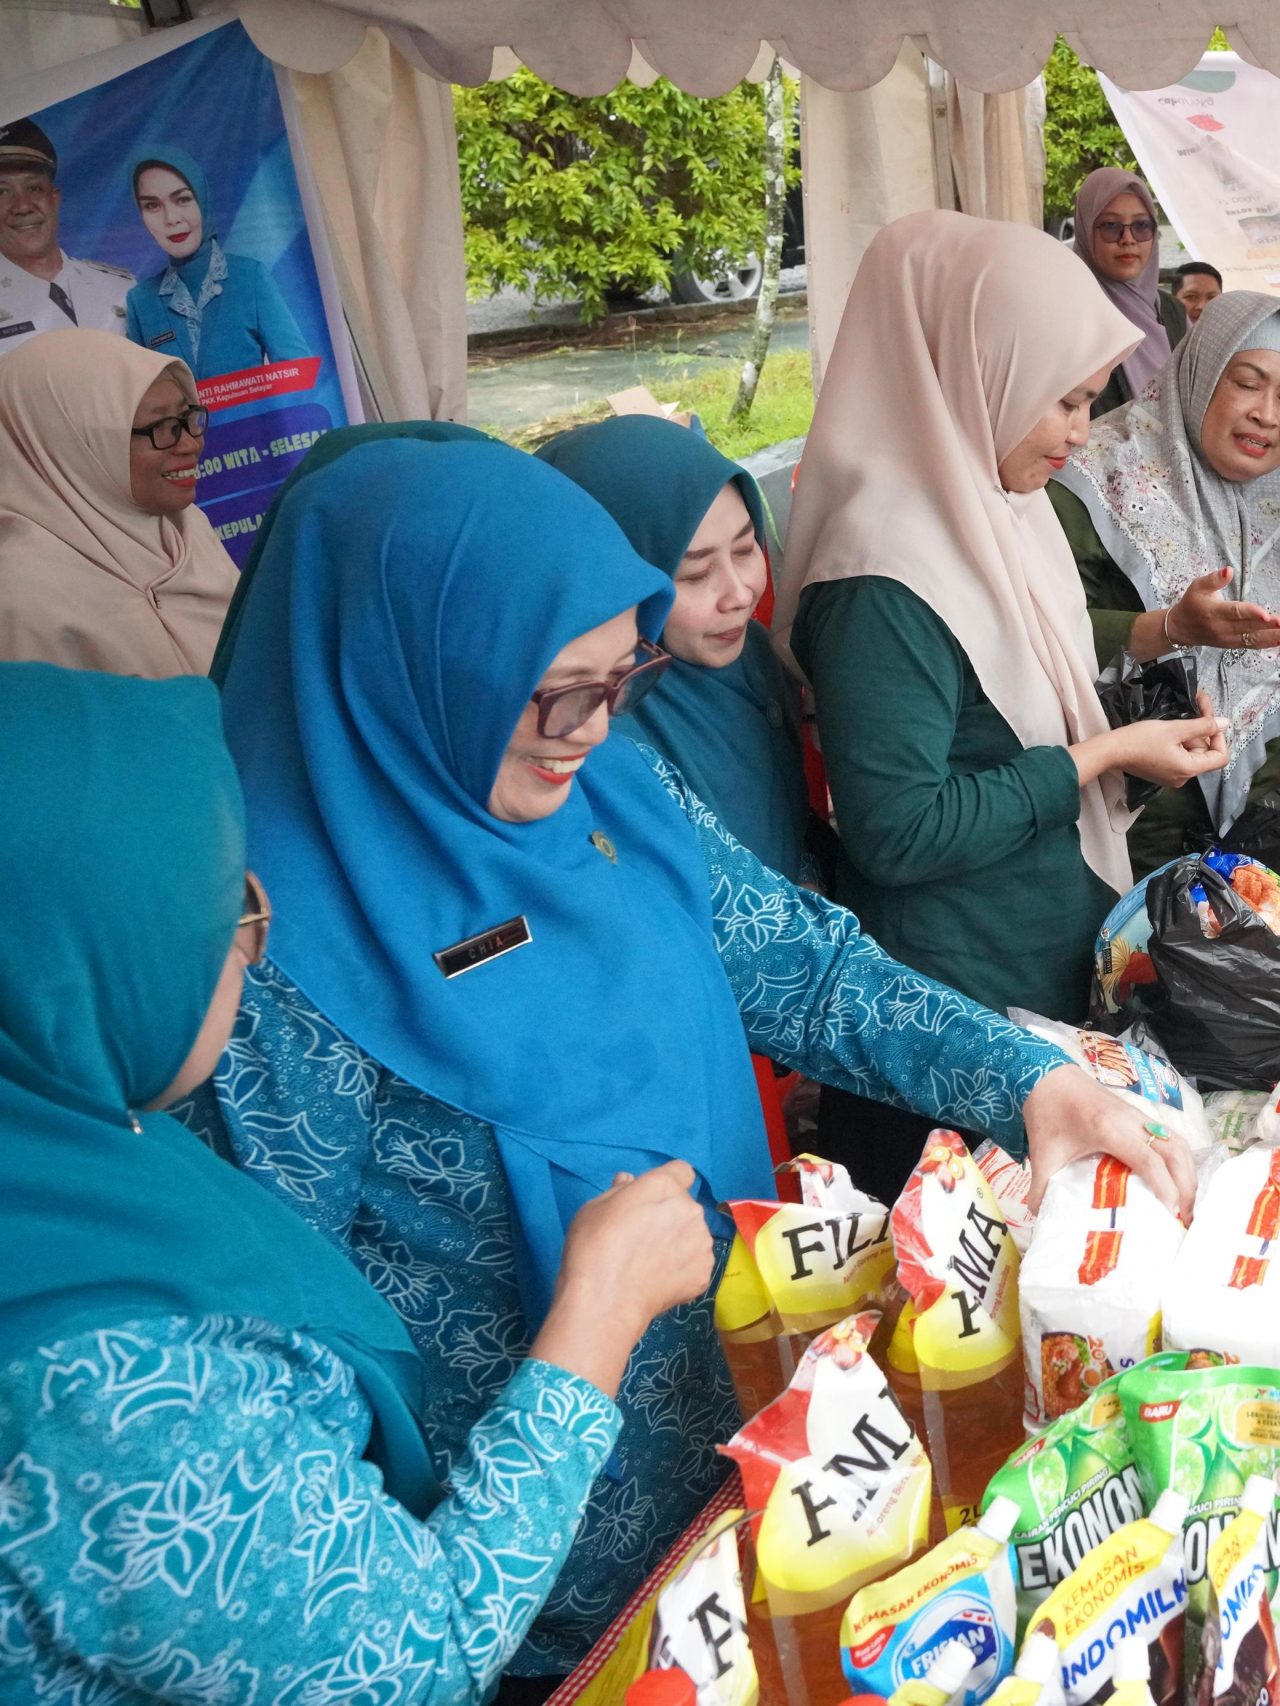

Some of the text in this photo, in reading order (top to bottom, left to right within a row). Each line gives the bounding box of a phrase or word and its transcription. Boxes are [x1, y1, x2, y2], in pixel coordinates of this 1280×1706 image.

[213, 375, 265, 394] RAHMAWATI
[265, 367, 300, 381] NATSIR
[223, 446, 262, 470] WITA
[270, 429, 328, 458] SELESA
[215, 511, 266, 540] KEPULA
[1087, 1334, 1106, 1362] 20
[1144, 1404, 1174, 1418] BARU
[1014, 1466, 1110, 1540] CAIRAN PENCUCI PIRING
[1186, 1495, 1242, 1518] NCUCI PIRIN
[853, 1551, 979, 1634] KEMASAN EKONOMIS
[1062, 1545, 1139, 1615] KEMASAN
[1065, 1563, 1146, 1636] EKONOMIS
[911, 1625, 986, 1677] FRIAN
[1061, 1568, 1188, 1691] INDOMILK
